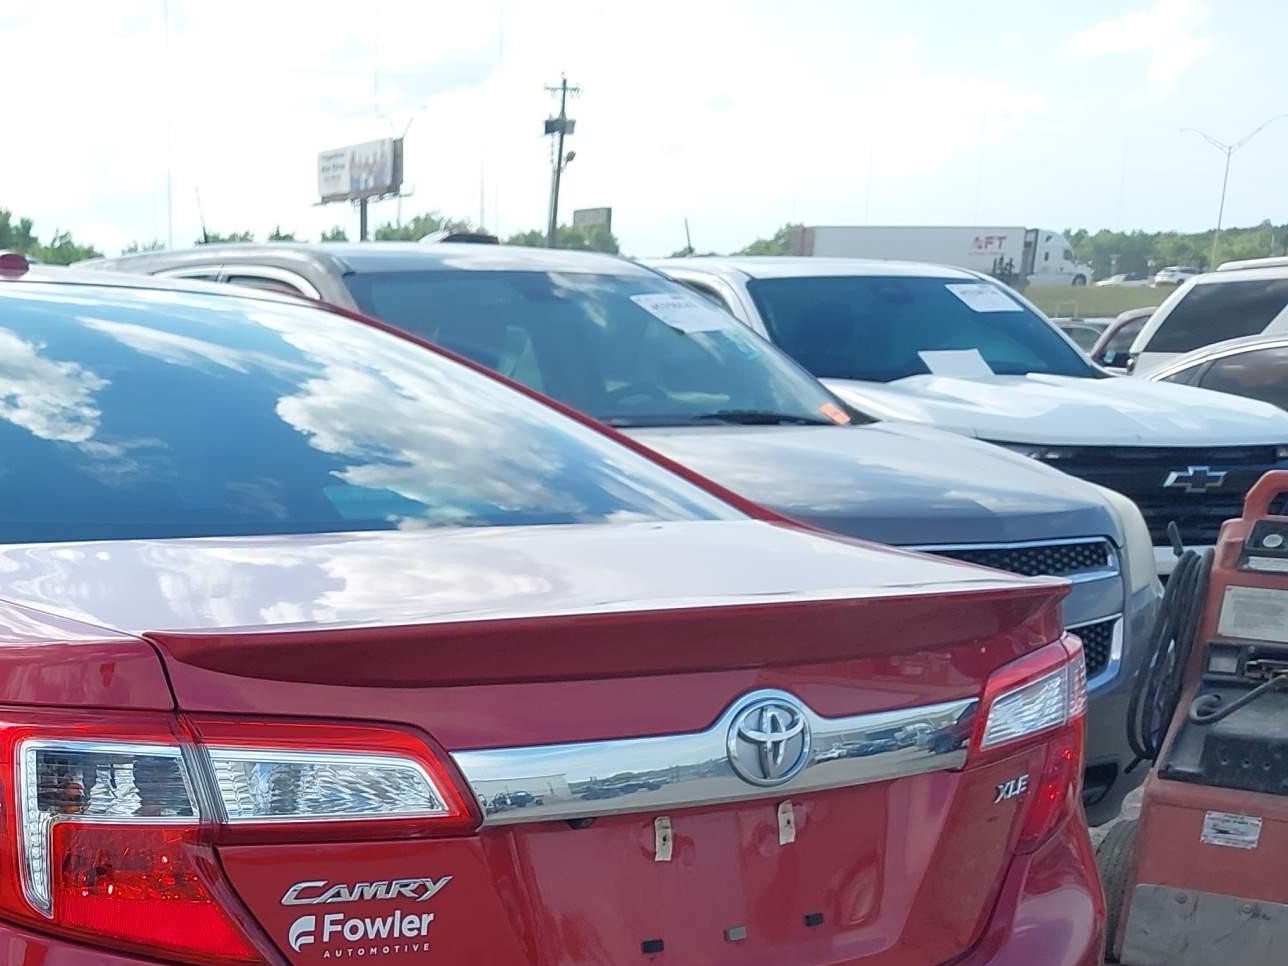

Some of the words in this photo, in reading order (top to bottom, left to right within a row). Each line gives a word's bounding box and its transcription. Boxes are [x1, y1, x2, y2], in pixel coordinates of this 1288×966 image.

[993, 774, 1029, 804] XLE
[322, 910, 435, 942] Fowler
[323, 943, 430, 959] AUTOMOTIVE
